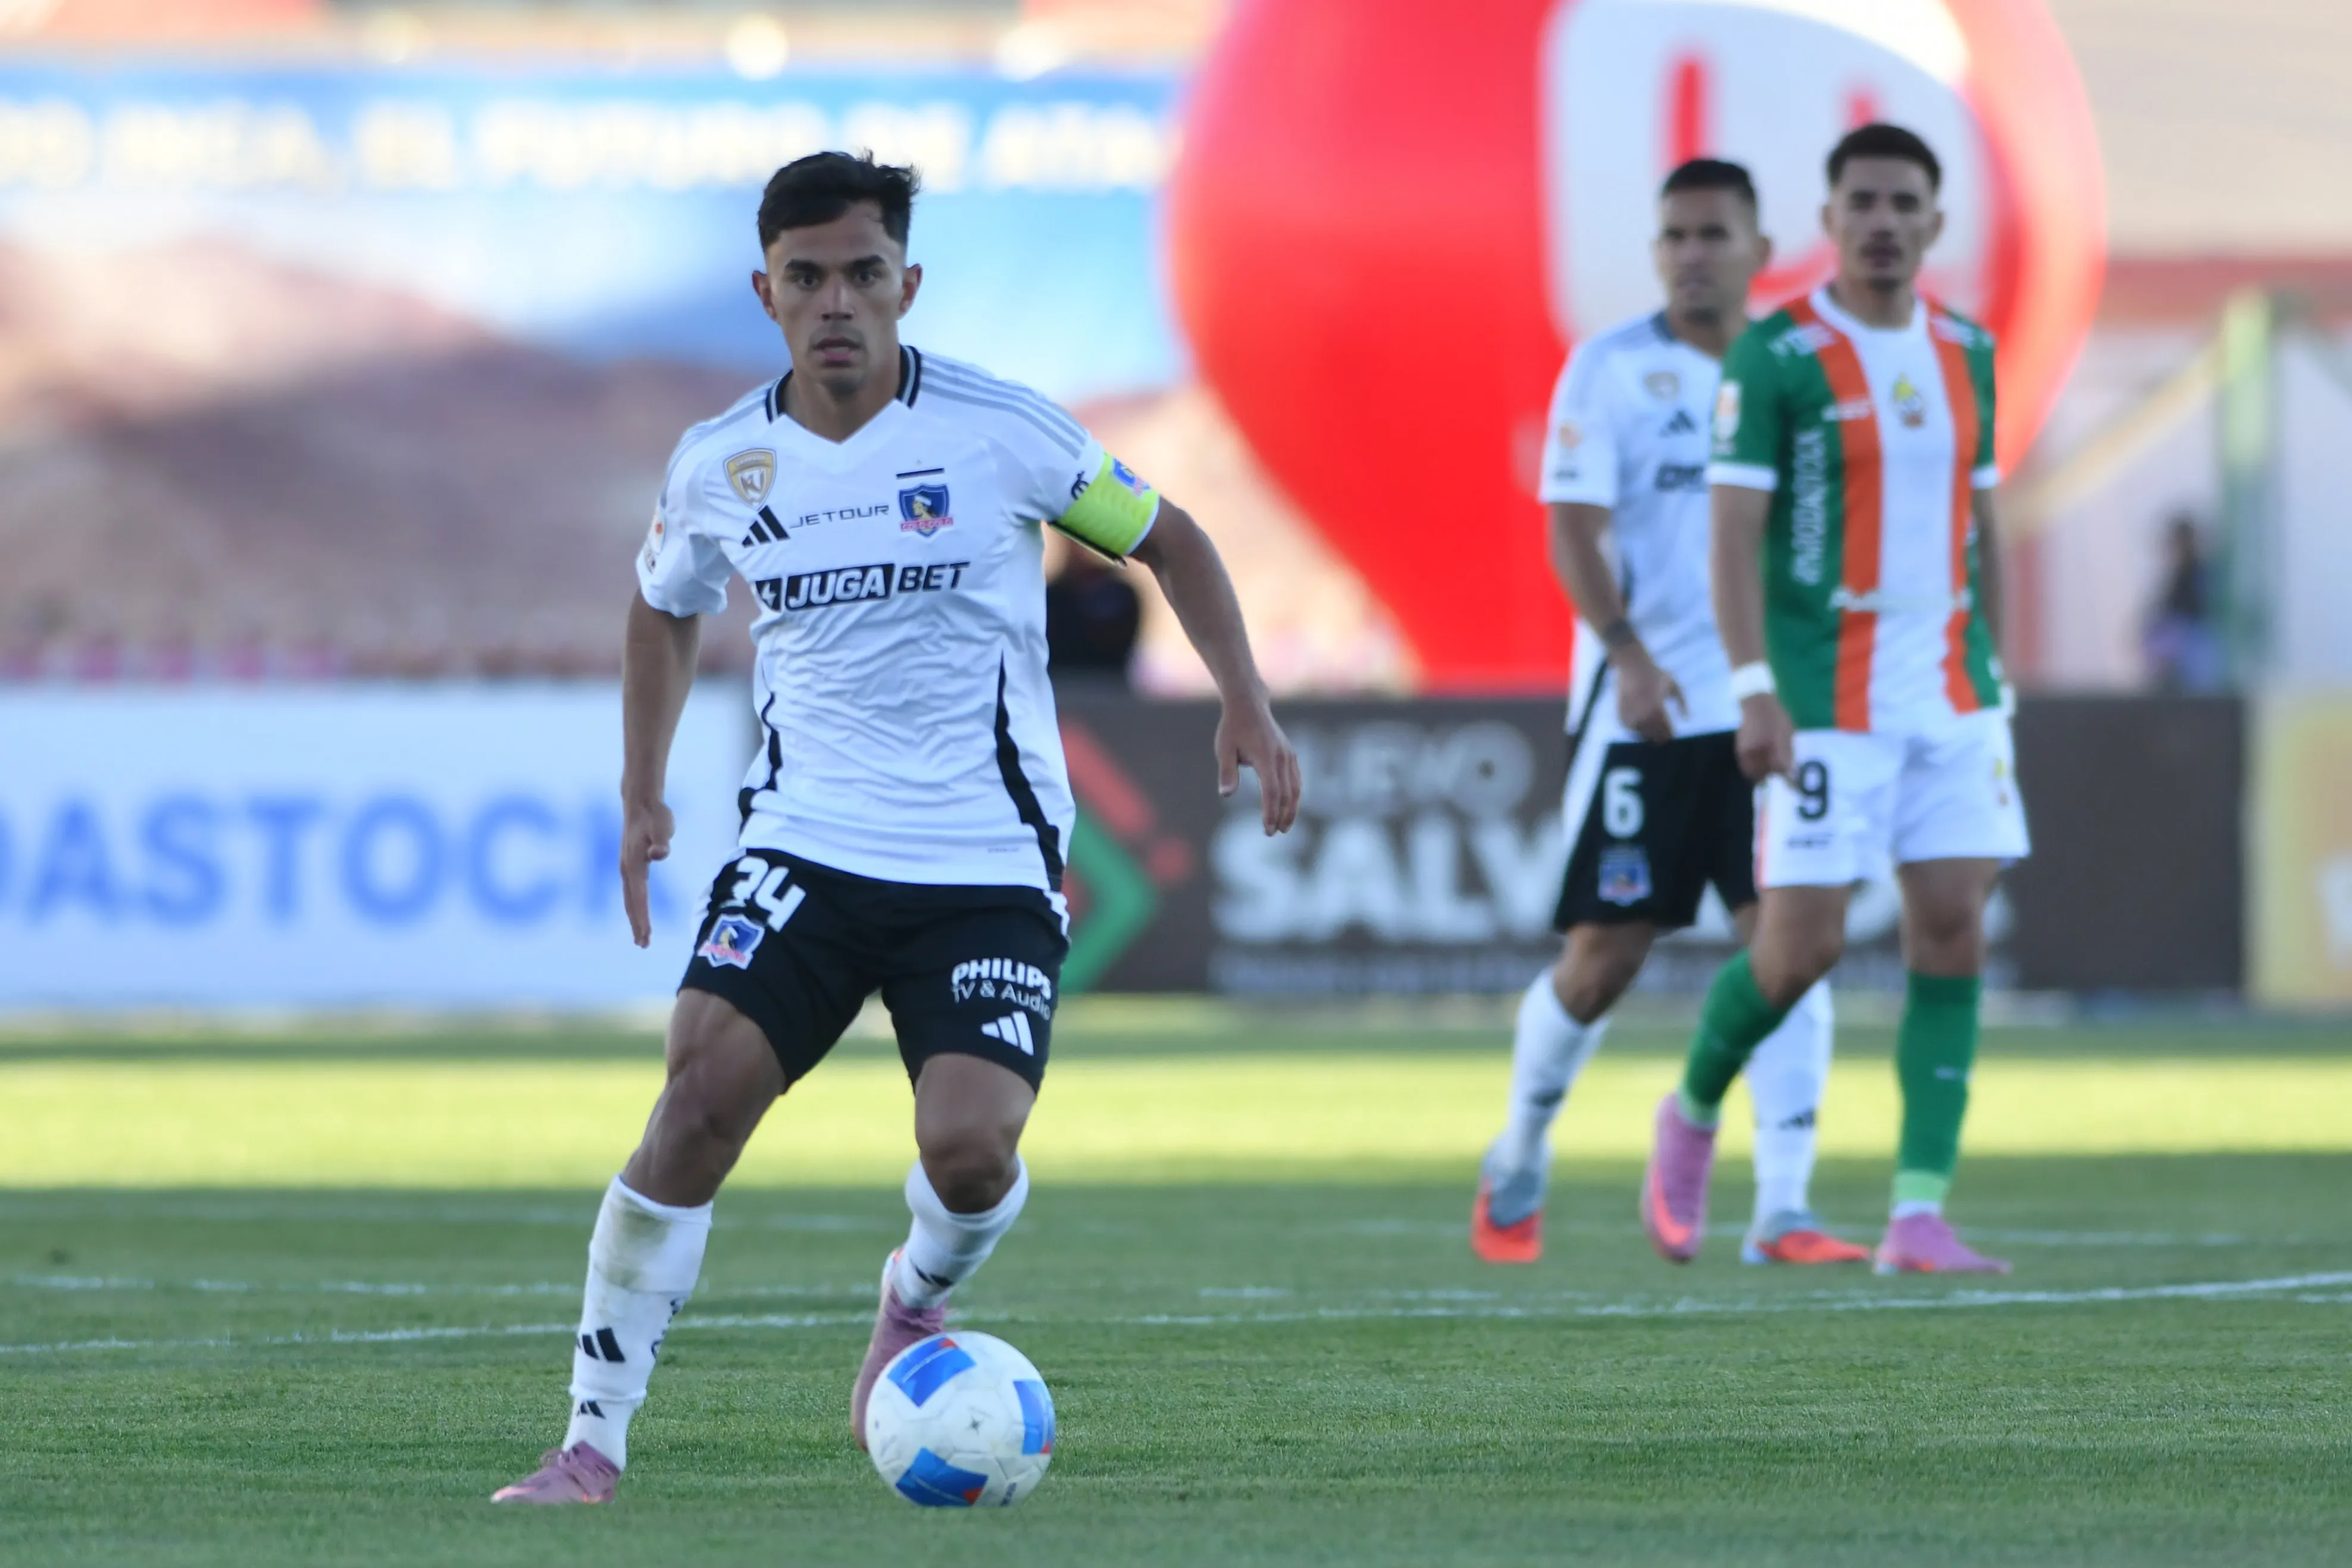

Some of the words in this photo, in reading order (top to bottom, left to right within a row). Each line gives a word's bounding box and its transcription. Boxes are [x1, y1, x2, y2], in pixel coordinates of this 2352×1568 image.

[790, 505, 889, 529] JETOUR
[1603, 766, 1645, 838] 6
[1799, 760, 1828, 820] 9
[720, 855, 807, 933] 24
[950, 981, 977, 1004] TV
[979, 979, 996, 998] &
